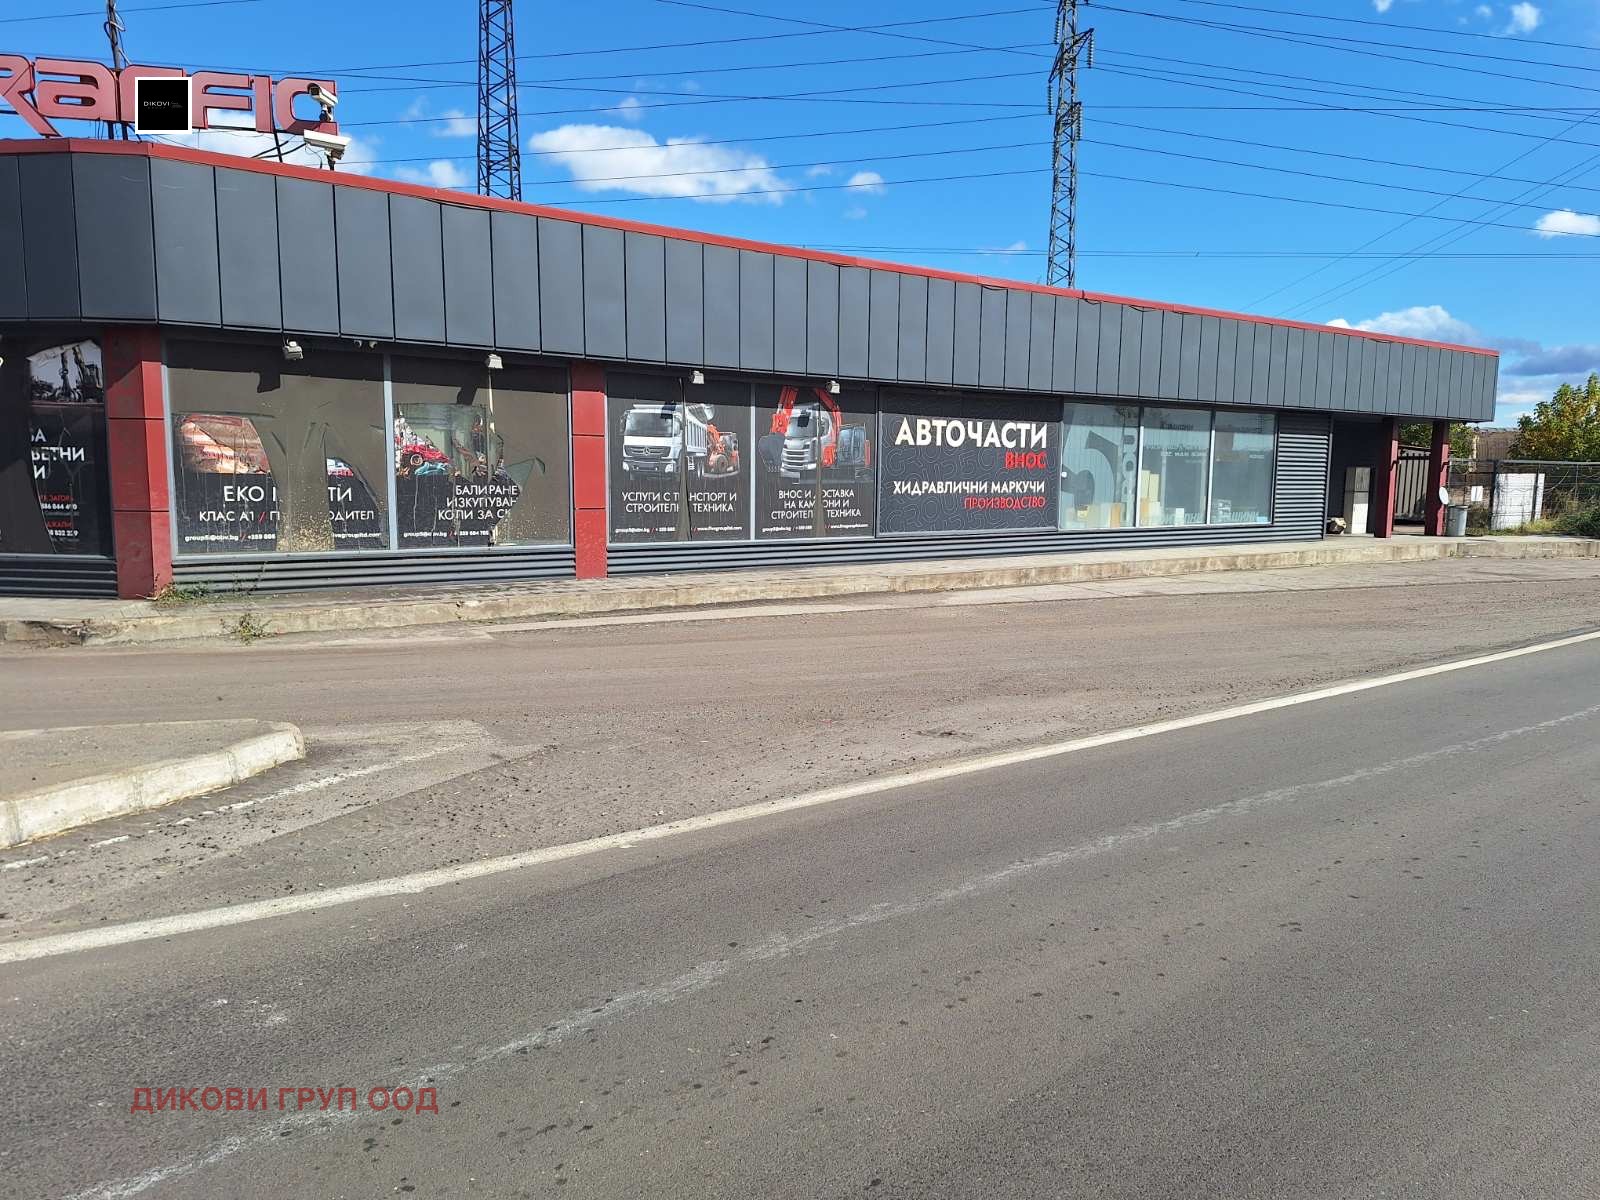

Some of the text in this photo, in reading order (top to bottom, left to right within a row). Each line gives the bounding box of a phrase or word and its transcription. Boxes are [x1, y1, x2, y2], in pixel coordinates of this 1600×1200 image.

[894, 416, 1048, 449] АВТОЧАСТИ
[1004, 452, 1047, 469] ВНОС
[223, 485, 264, 502] ЕКО
[455, 485, 518, 496] БАЛИРАНЕ
[893, 480, 1046, 496] ХИДРАВЛИЧНИ МАРКУЧИ
[622, 491, 660, 502] УСЛУГИ
[663, 492, 671, 501] С
[729, 491, 737, 501] И
[778, 490, 802, 499] ВНОС
[804, 490, 812, 499] И
[625, 502, 734, 513] СТРОИТЕЛ ТЕХНИКА
[784, 500, 797, 509] НА
[842, 498, 850, 508] И
[964, 496, 1046, 509] ПРОИЗВОДСТВО
[199, 510, 236, 522] КЛАС
[239, 510, 255, 522] А1
[438, 509, 474, 521] КОЛИ
[477, 509, 494, 520] ЗА
[827, 508, 861, 518] ТЕХНИКА
